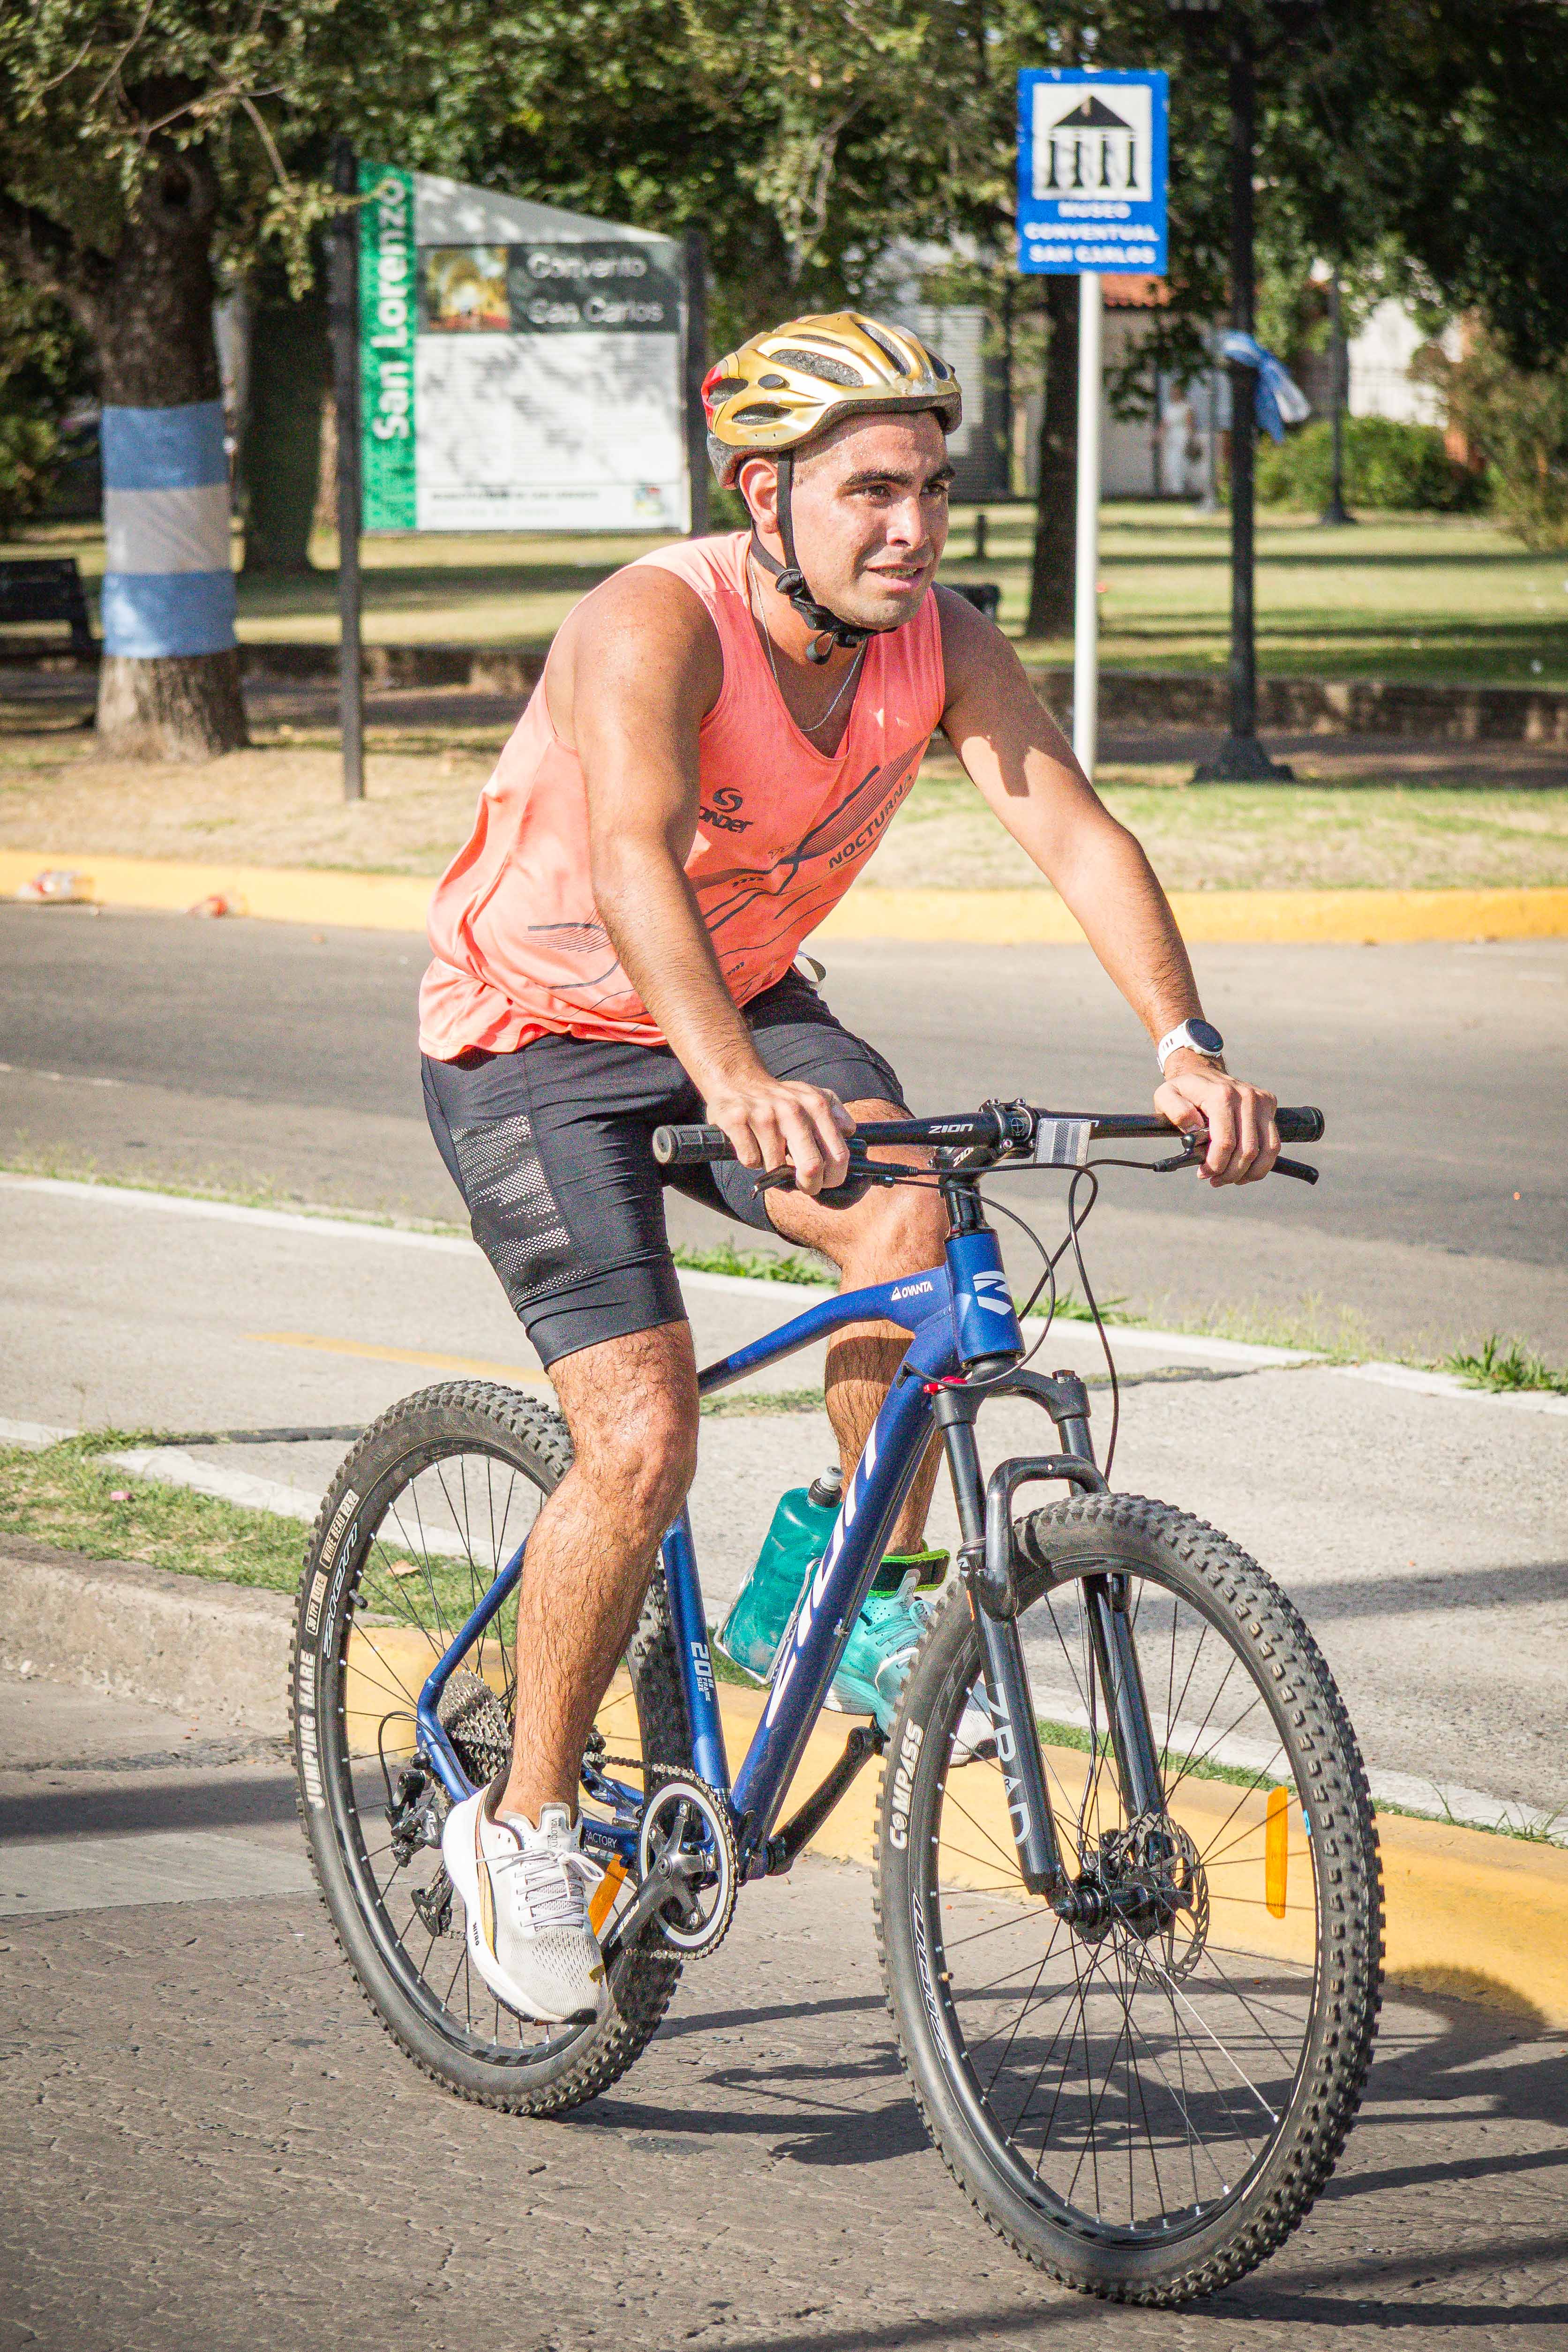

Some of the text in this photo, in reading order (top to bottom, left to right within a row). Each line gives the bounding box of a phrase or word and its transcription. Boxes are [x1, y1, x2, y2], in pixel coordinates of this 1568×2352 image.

[527, 252, 647, 278] Convento
[1029, 244, 1156, 263] SAN CARLOS
[372, 178, 409, 440] San Lorenzo
[527, 296, 664, 323] San Carlos
[828, 774, 912, 868] NOCTURNA
[322, 1536, 336, 1563] WIRE
[299, 1649, 326, 1809] JUMPING HARE
